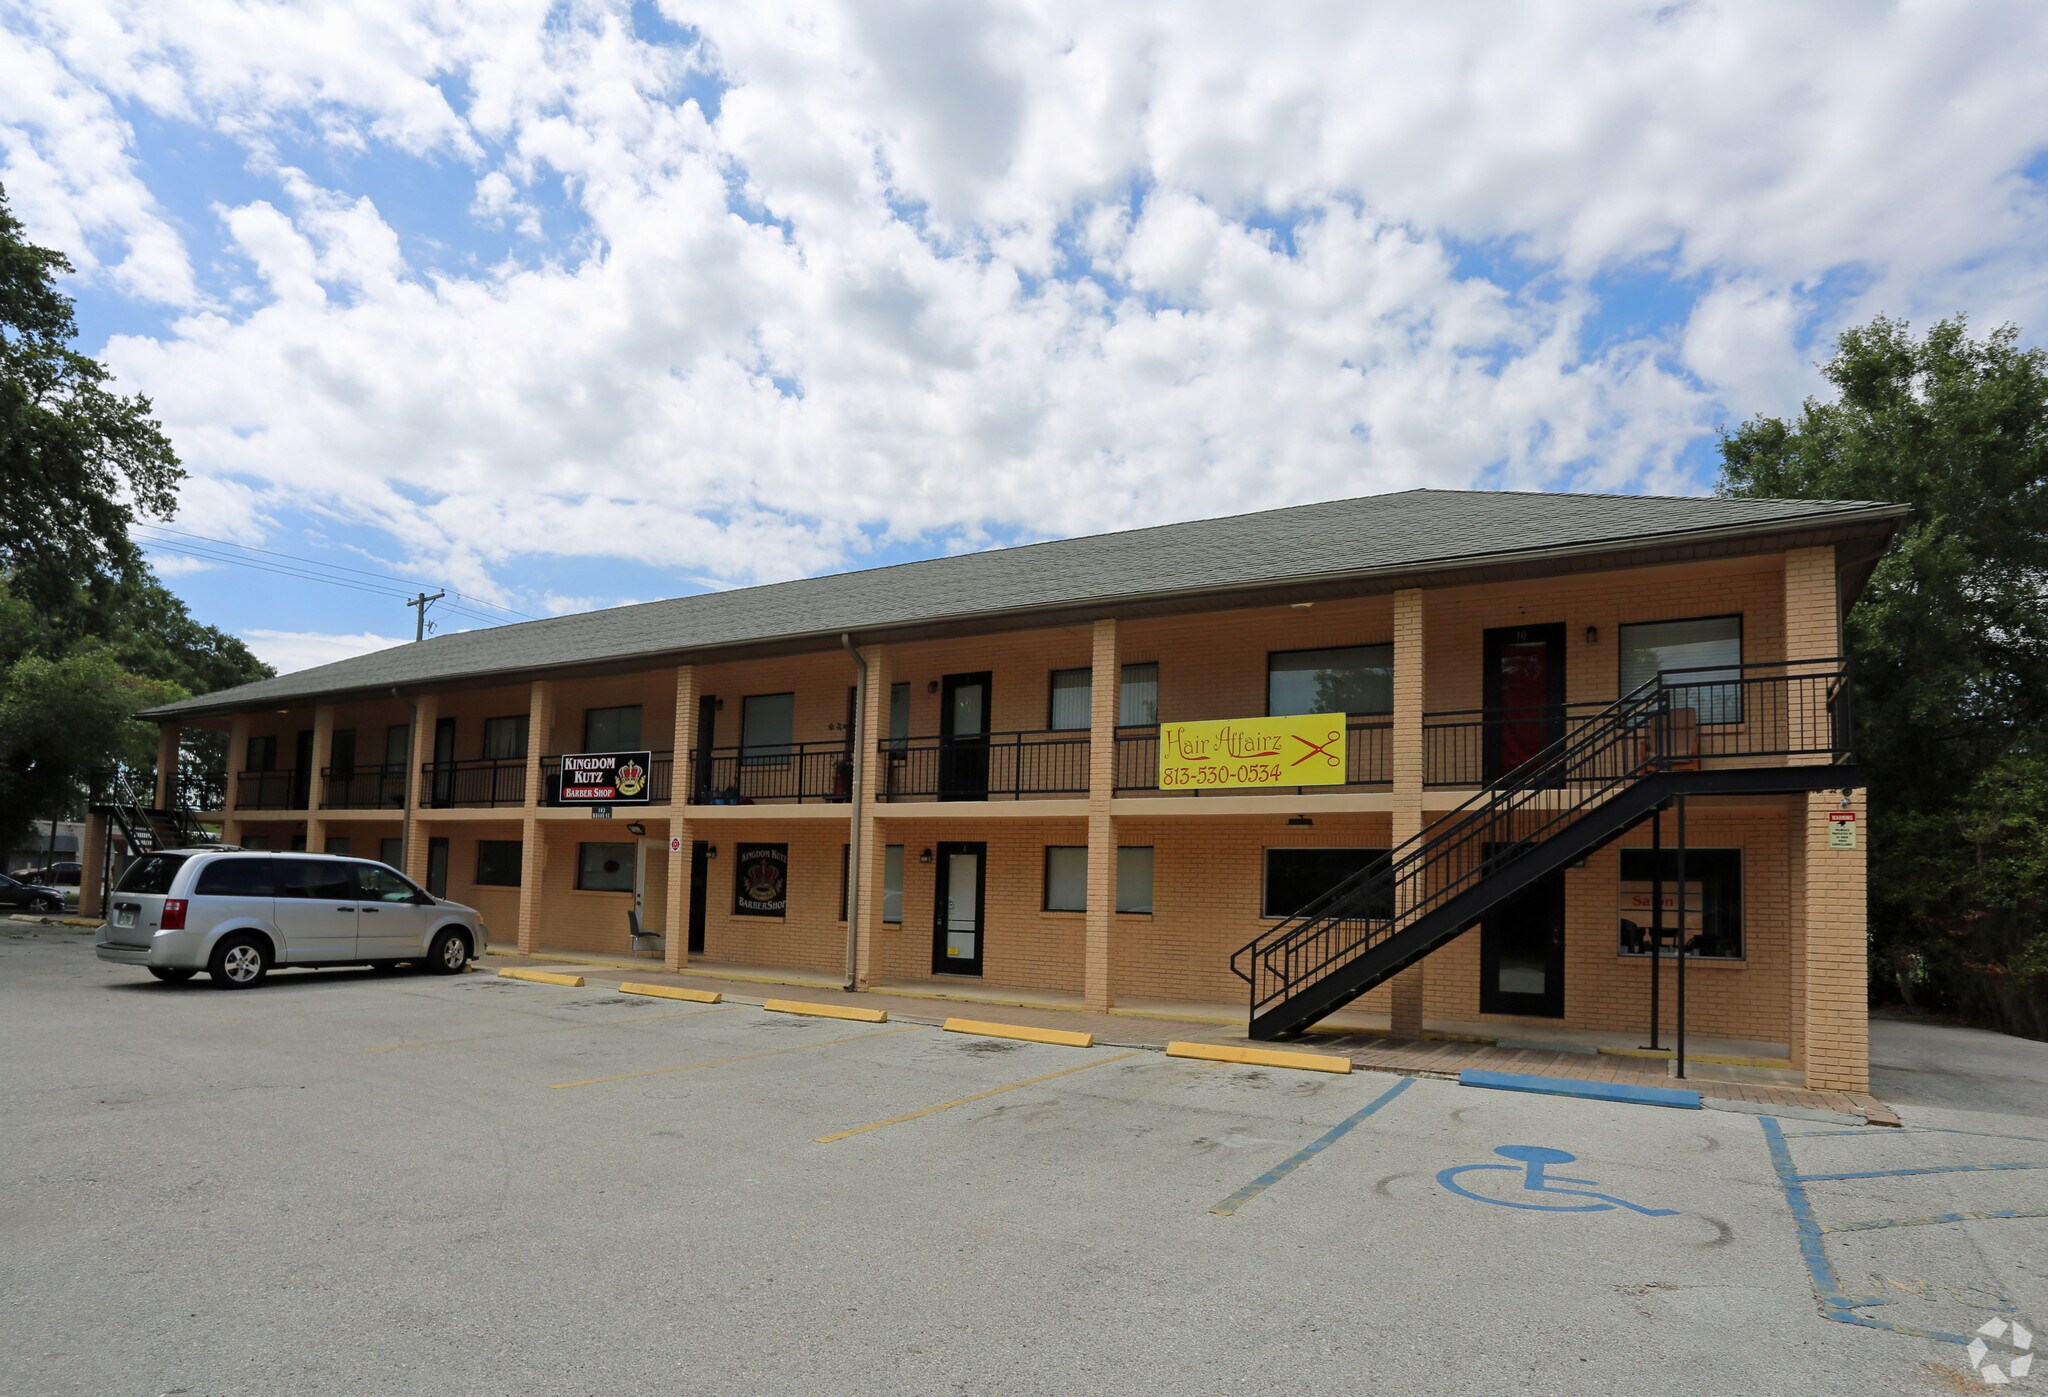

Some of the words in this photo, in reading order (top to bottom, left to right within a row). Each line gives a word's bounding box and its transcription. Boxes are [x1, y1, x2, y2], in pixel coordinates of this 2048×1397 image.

[1164, 726, 1210, 760] Hair
[1213, 725, 1282, 759] Affairz
[565, 758, 615, 770] KINGDOM
[574, 771, 603, 783] KUTZ
[1163, 764, 1282, 786] 813-530-0534
[566, 789, 592, 797] BARBER
[594, 788, 612, 797] SHOP
[742, 850, 770, 862] KINGDOM
[771, 849, 787, 863] KUTZ
[1633, 896, 1674, 907] San
